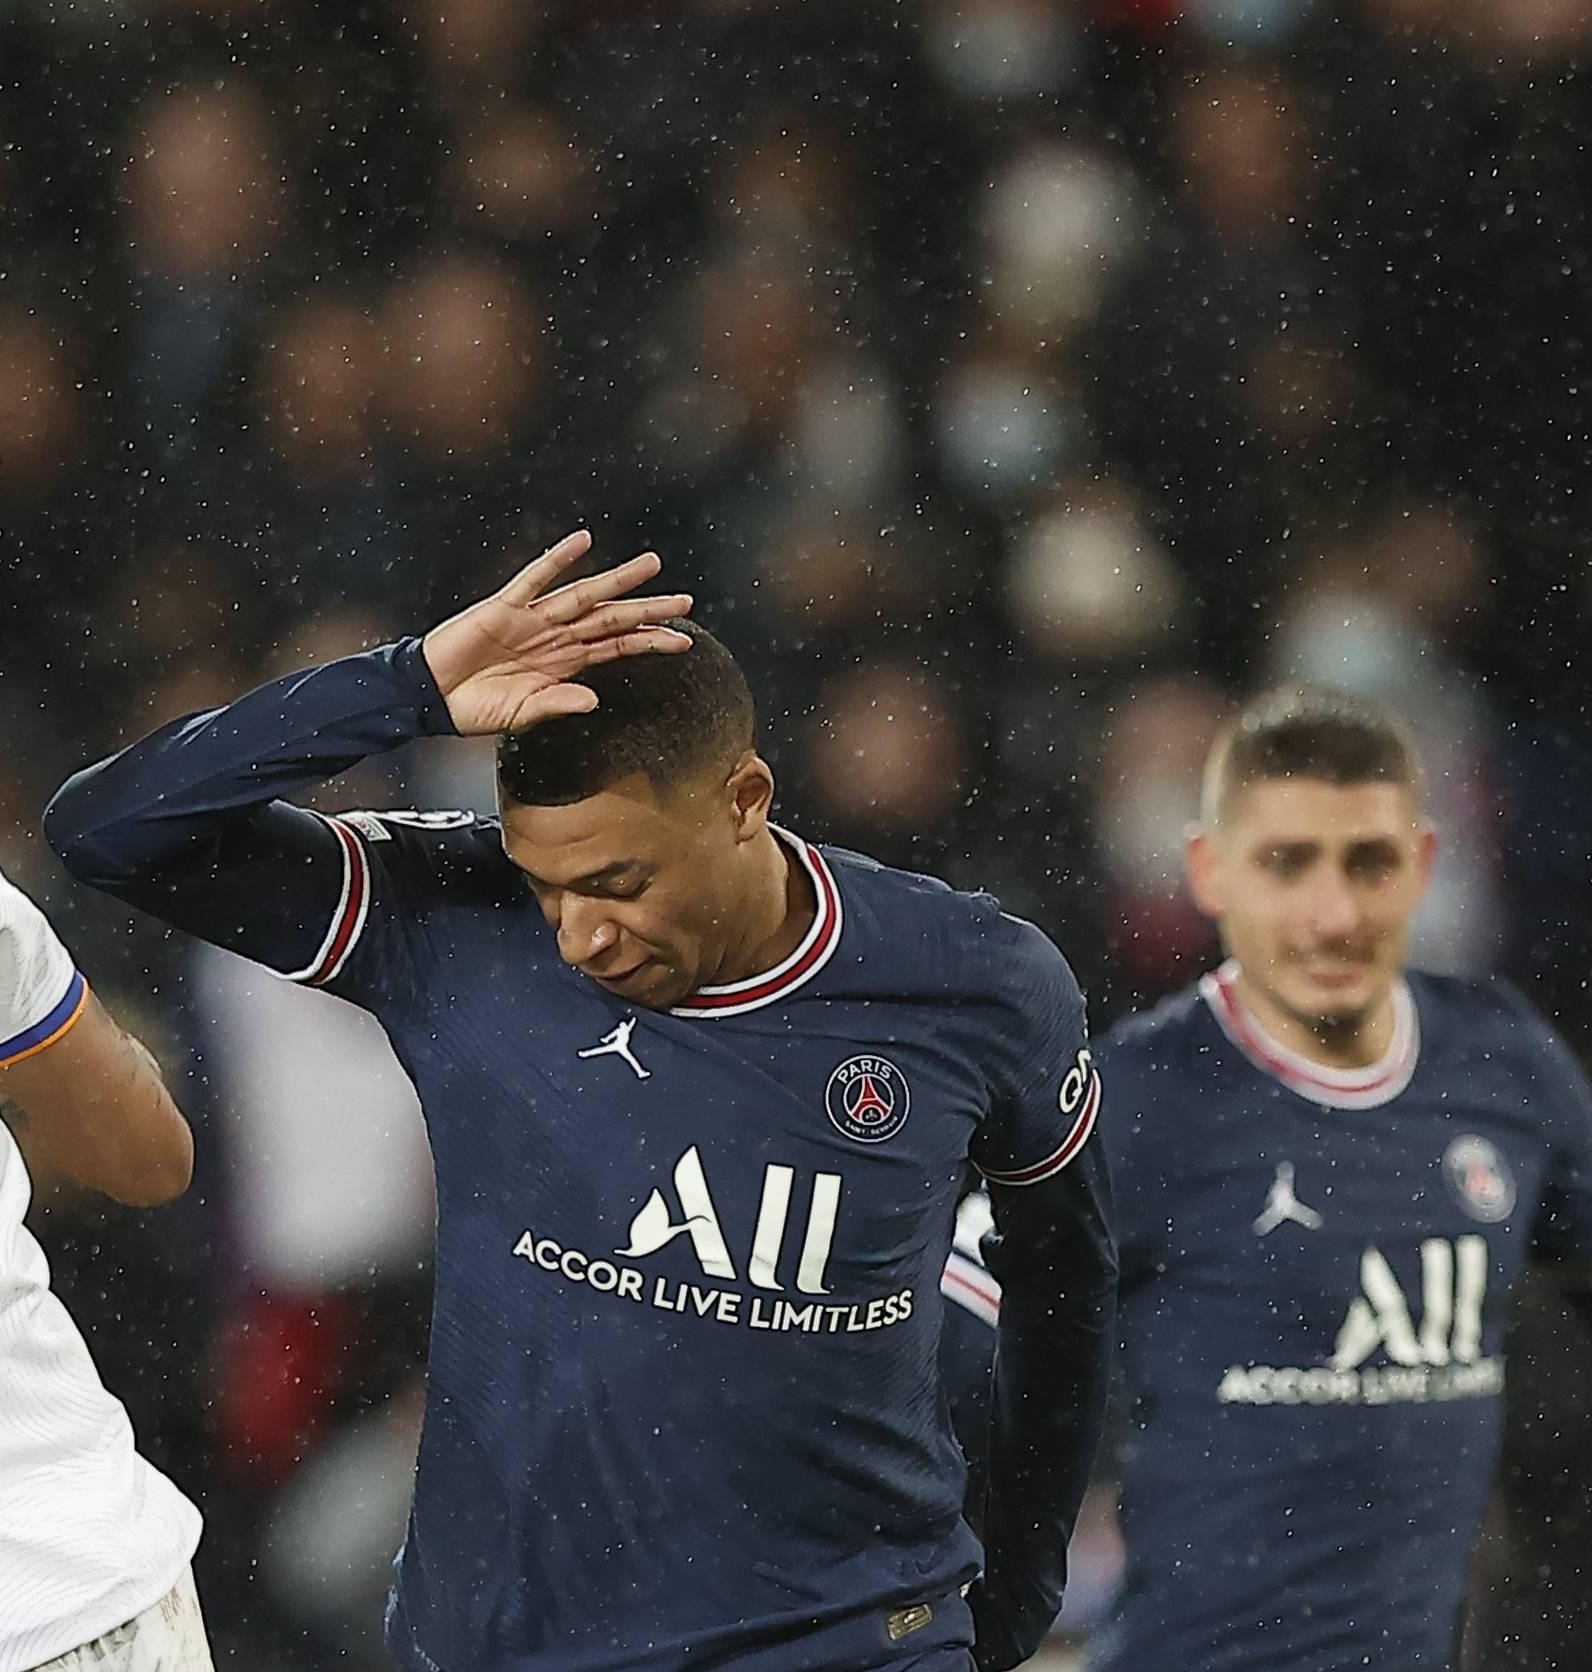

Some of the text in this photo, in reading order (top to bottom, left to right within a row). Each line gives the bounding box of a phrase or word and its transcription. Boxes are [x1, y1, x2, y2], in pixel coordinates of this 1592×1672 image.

[837, 1059, 893, 1084] PARIS
[512, 1230, 913, 1332] ACCOR LIVE LIMITLESS
